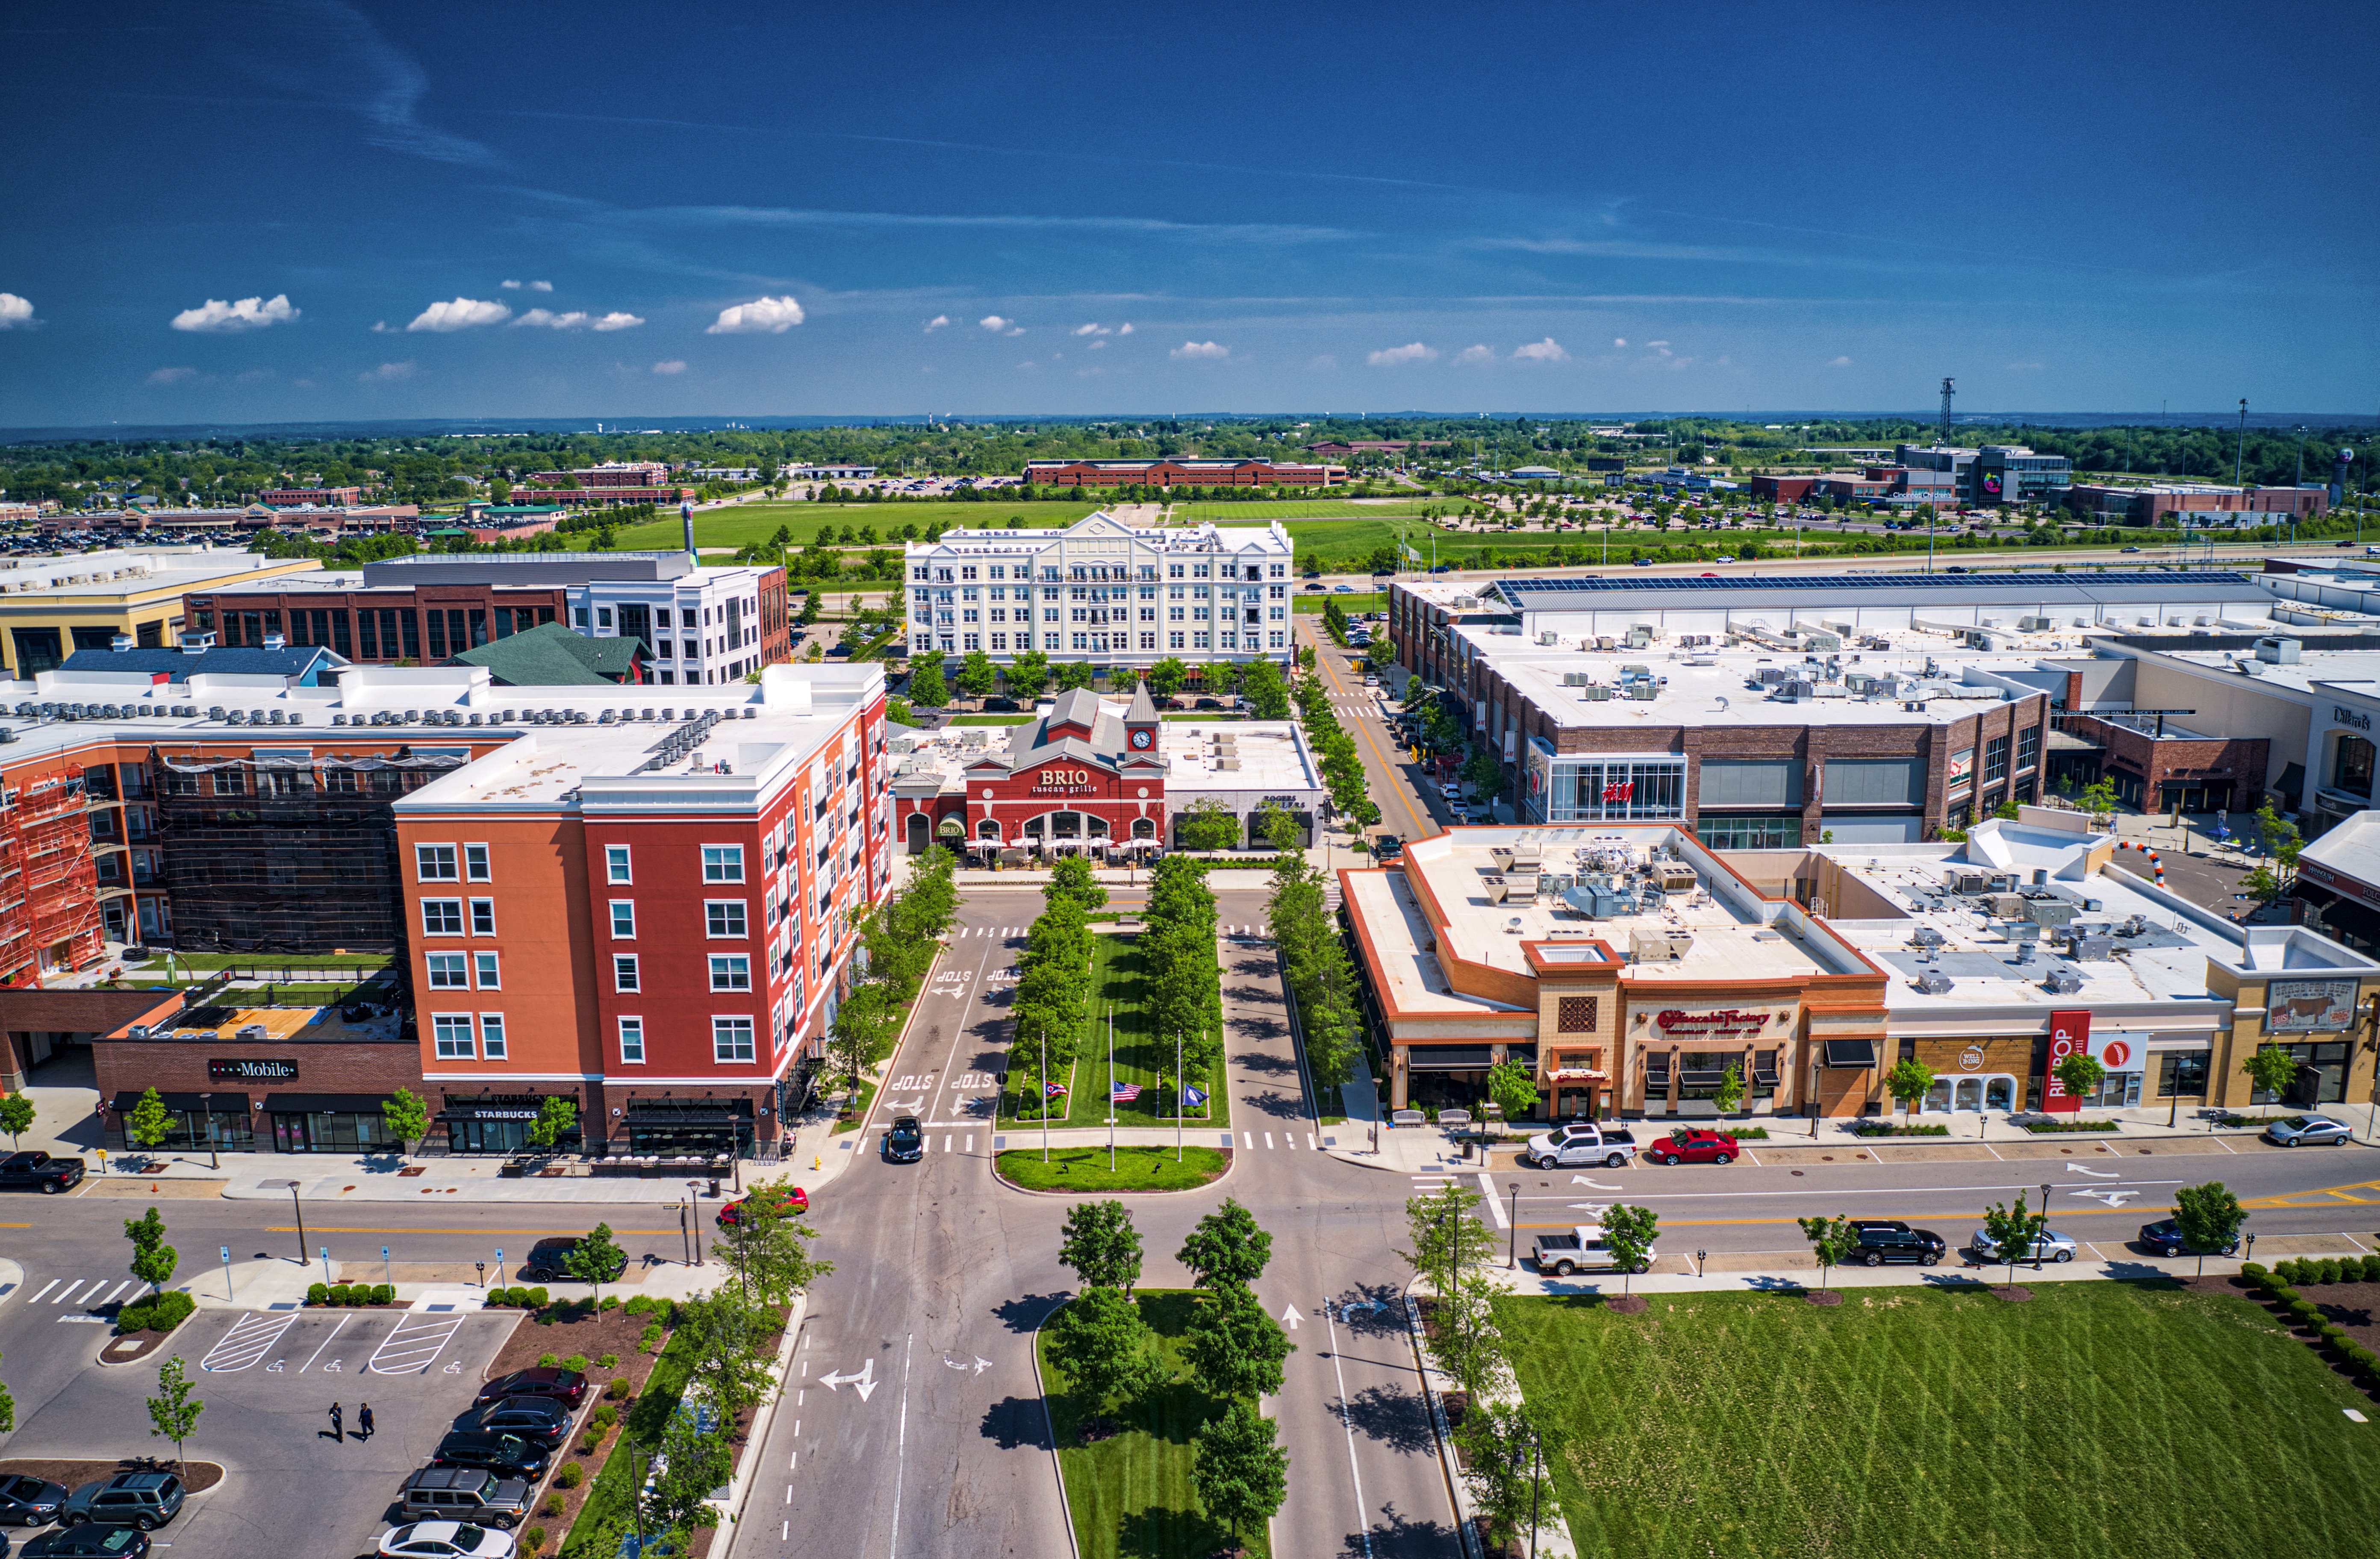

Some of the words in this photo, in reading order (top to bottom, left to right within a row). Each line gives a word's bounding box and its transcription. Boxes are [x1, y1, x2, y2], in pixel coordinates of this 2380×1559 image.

[2333, 707, 2369, 731] Dillard's
[1041, 770, 1088, 785] BRIO
[1069, 785, 1097, 793] grille
[1602, 782, 1635, 803] H&M
[936, 971, 972, 982] STOP
[986, 970, 1022, 981] STOP
[2275, 984, 2305, 996] GRASS
[2309, 983, 2326, 992] FED
[2328, 983, 2352, 994] BEEF
[1658, 1010, 1723, 1029] Cheesecake
[1719, 1009, 1770, 1027] Factory
[240, 1062, 289, 1076] Mobile
[891, 1075, 935, 1091] STOP
[951, 1074, 993, 1089] STOP
